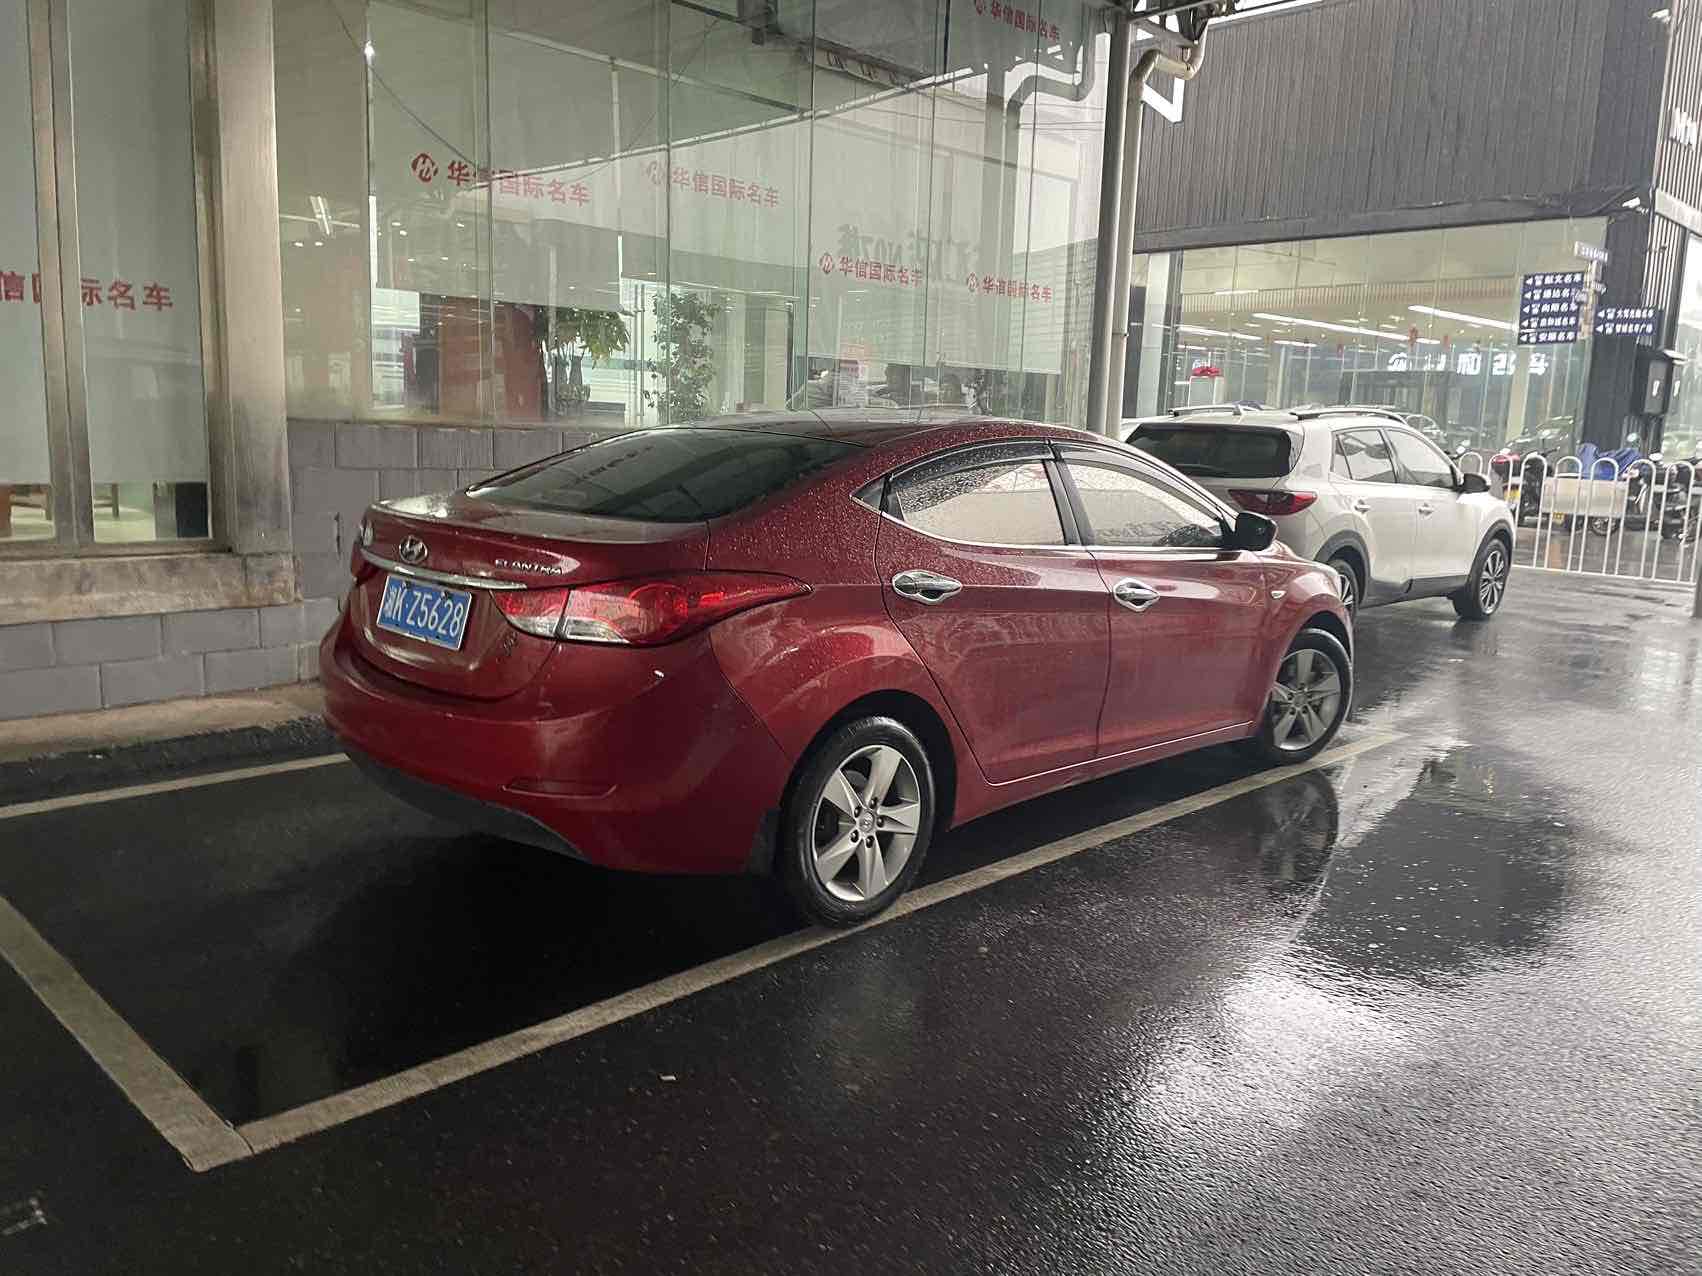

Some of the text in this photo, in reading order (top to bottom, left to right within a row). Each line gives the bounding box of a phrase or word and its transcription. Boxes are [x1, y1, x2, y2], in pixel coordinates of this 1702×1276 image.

[671, 168, 779, 208] 华信国际名车
[839, 256, 923, 287] 华信国际名车
[982, 274, 1052, 303] 华信国际名车
